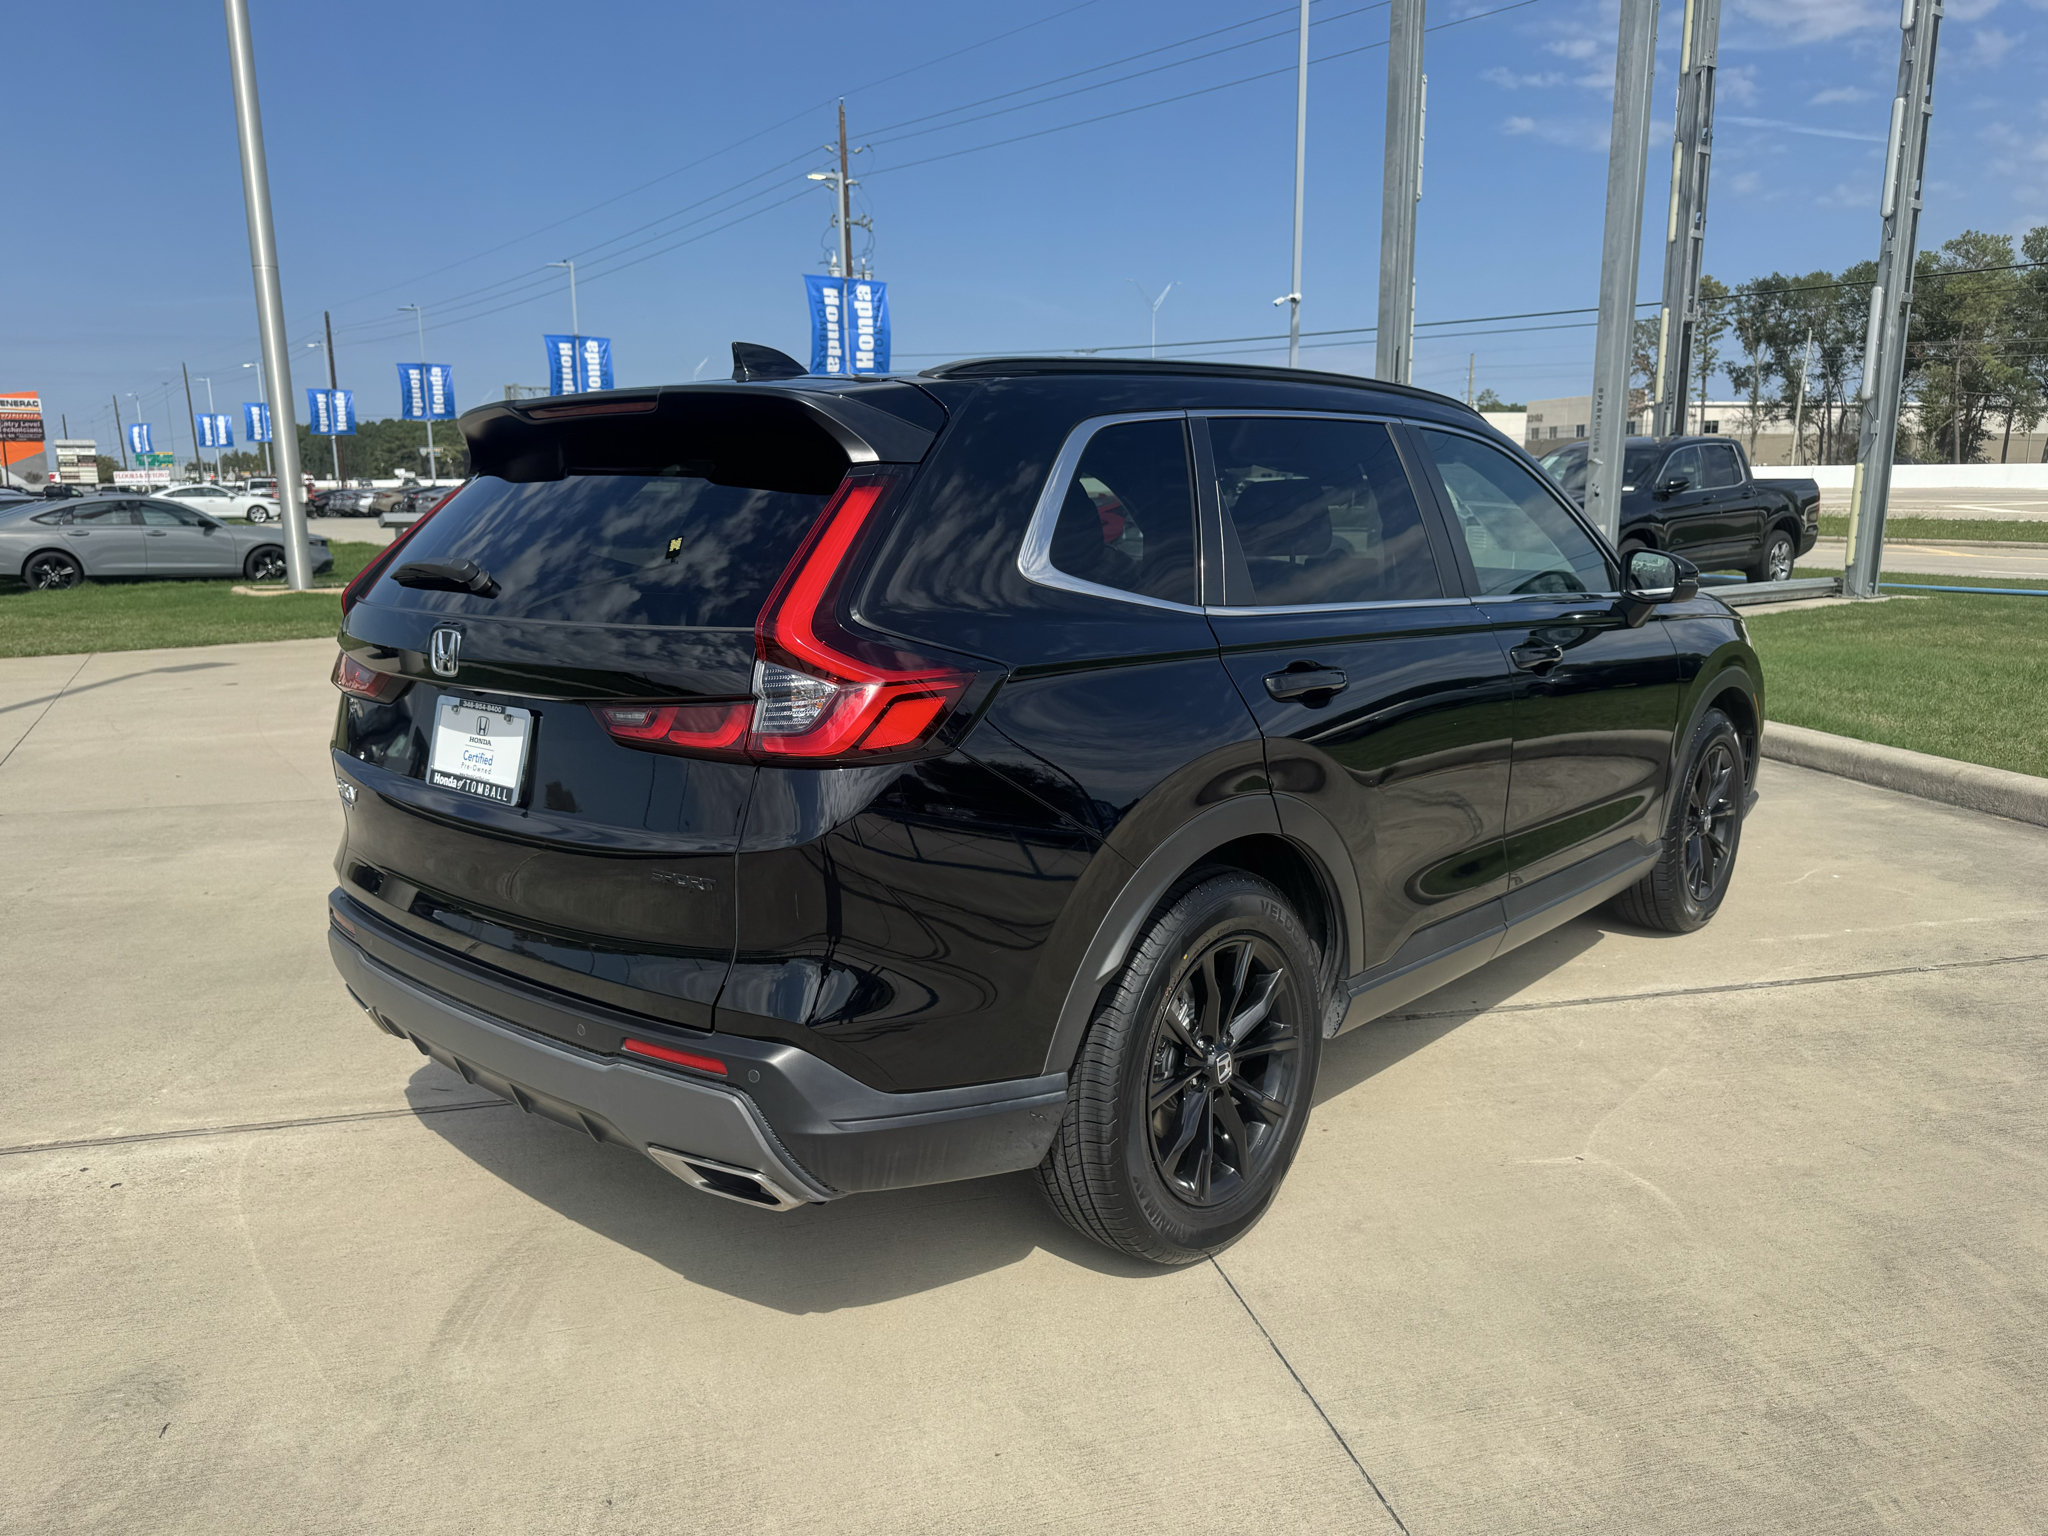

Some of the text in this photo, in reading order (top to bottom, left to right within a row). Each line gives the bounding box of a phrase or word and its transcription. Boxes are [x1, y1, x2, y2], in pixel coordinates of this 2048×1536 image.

[823, 287, 842, 373] Honda
[853, 284, 875, 369] Honda
[430, 366, 446, 414] Honda
[558, 342, 576, 395] Hond
[584, 340, 602, 392] onda
[0, 399, 39, 408] ENERAC
[408, 368, 424, 417] Honda
[463, 749, 494, 766] Certified
[469, 736, 492, 746] HONDA
[433, 772, 508, 801] Honda of TOMBALL
[460, 761, 492, 775] Pre-Owned
